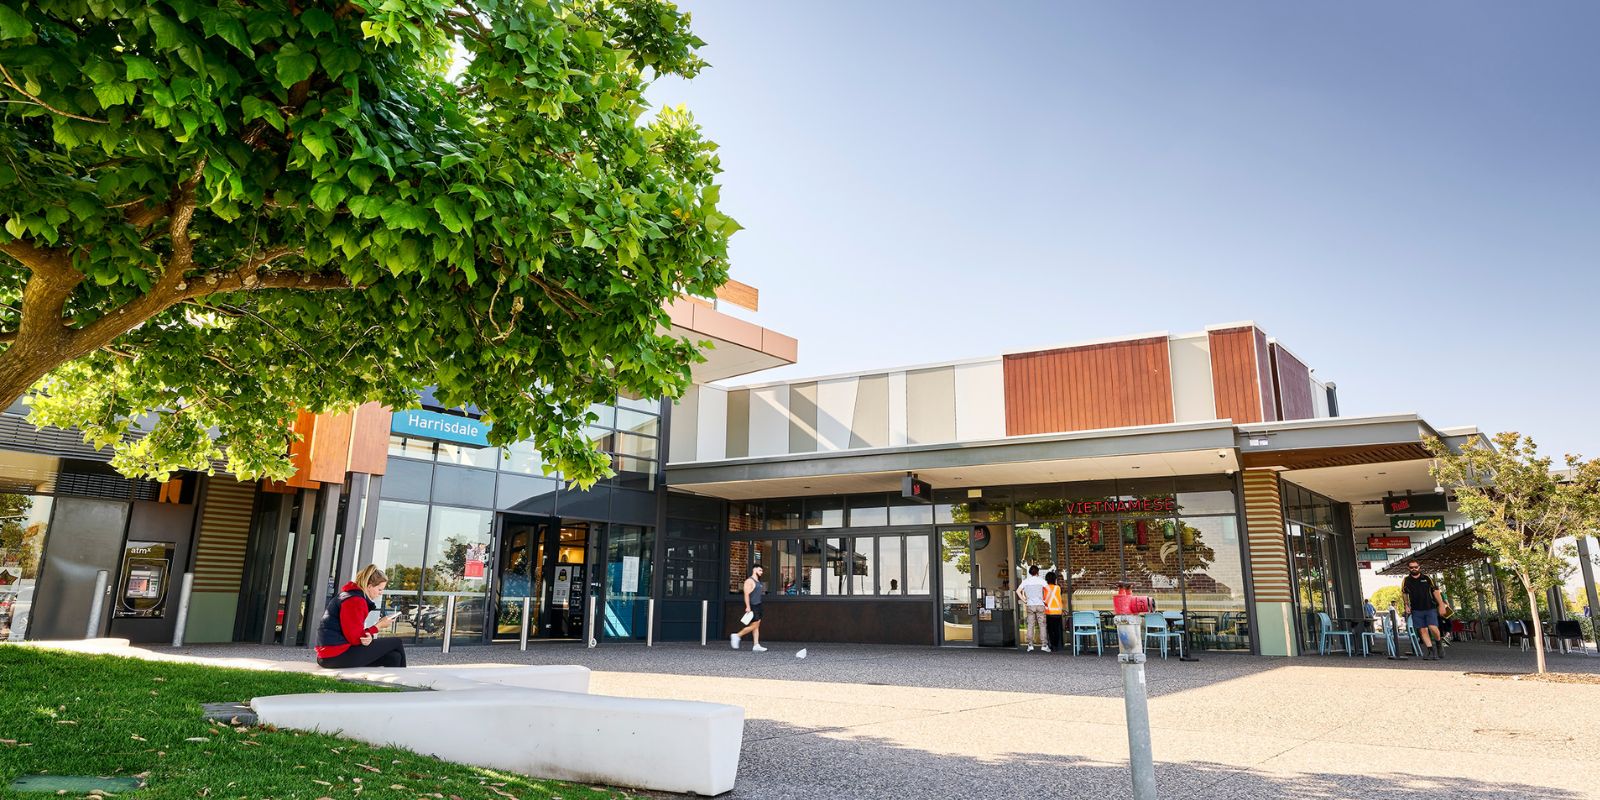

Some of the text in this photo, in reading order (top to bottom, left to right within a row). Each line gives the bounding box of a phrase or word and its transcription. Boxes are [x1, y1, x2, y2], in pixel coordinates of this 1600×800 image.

[409, 414, 478, 436] Harrisdale
[1067, 498, 1174, 514] VIETNAMESE
[1394, 518, 1442, 529] SUBWAY
